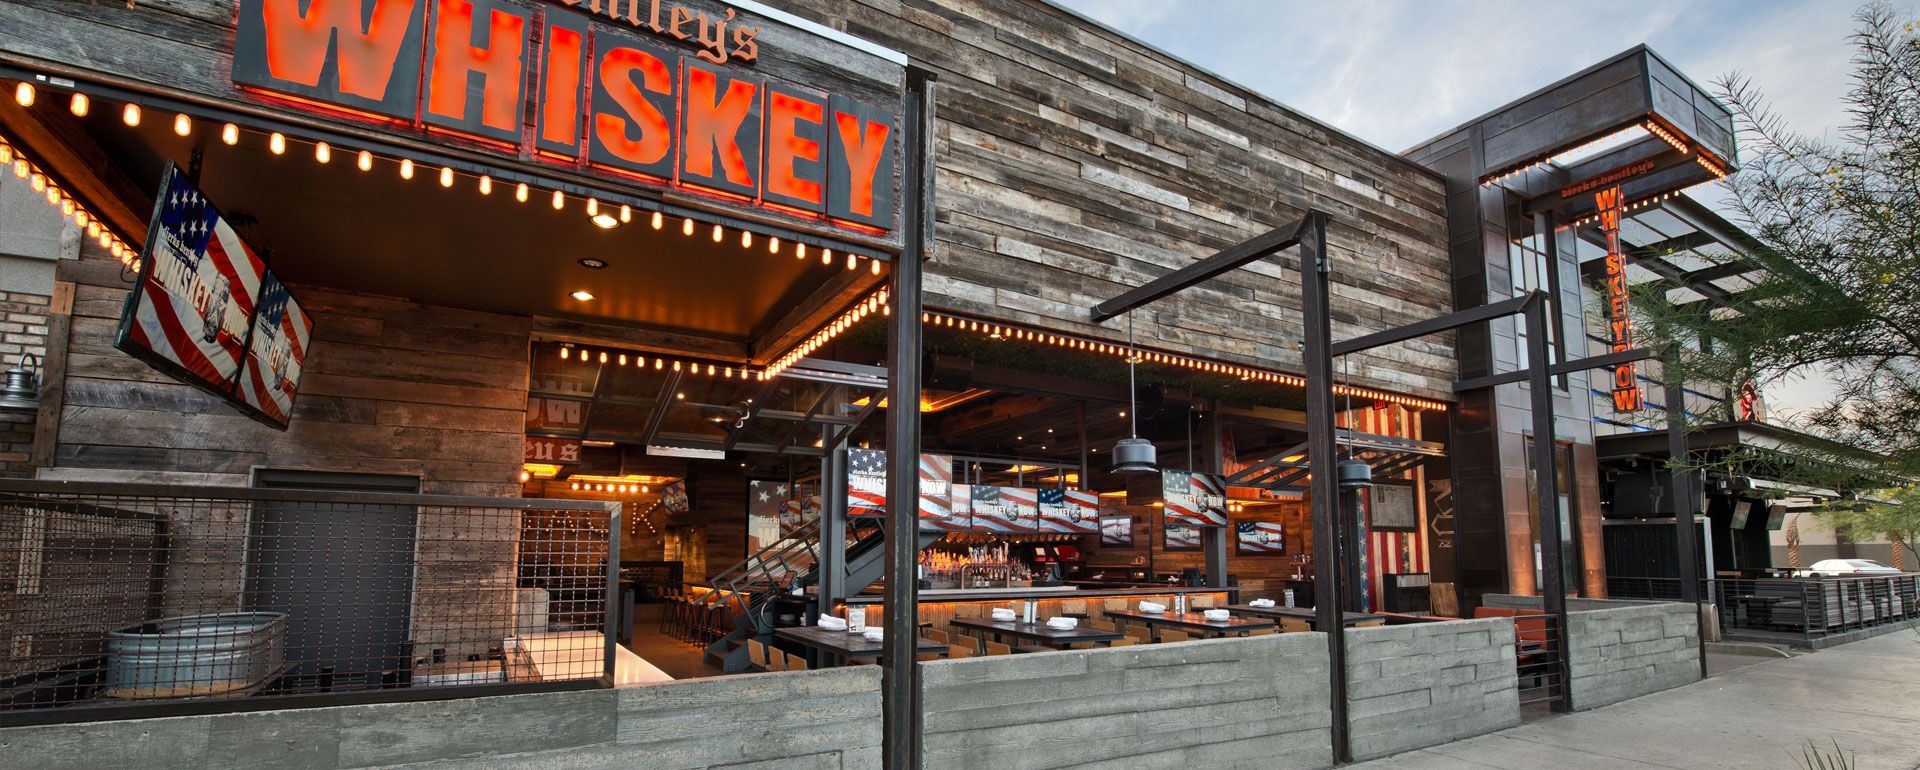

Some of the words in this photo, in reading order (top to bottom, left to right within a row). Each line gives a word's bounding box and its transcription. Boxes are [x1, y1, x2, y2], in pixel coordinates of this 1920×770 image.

[262, 0, 889, 217] WHISKEY
[153, 244, 212, 313] WHISKEY
[1595, 187, 1625, 341] WHISKEY
[975, 504, 1007, 516] WHISKEY
[1042, 507, 1070, 518] WHISKEY
